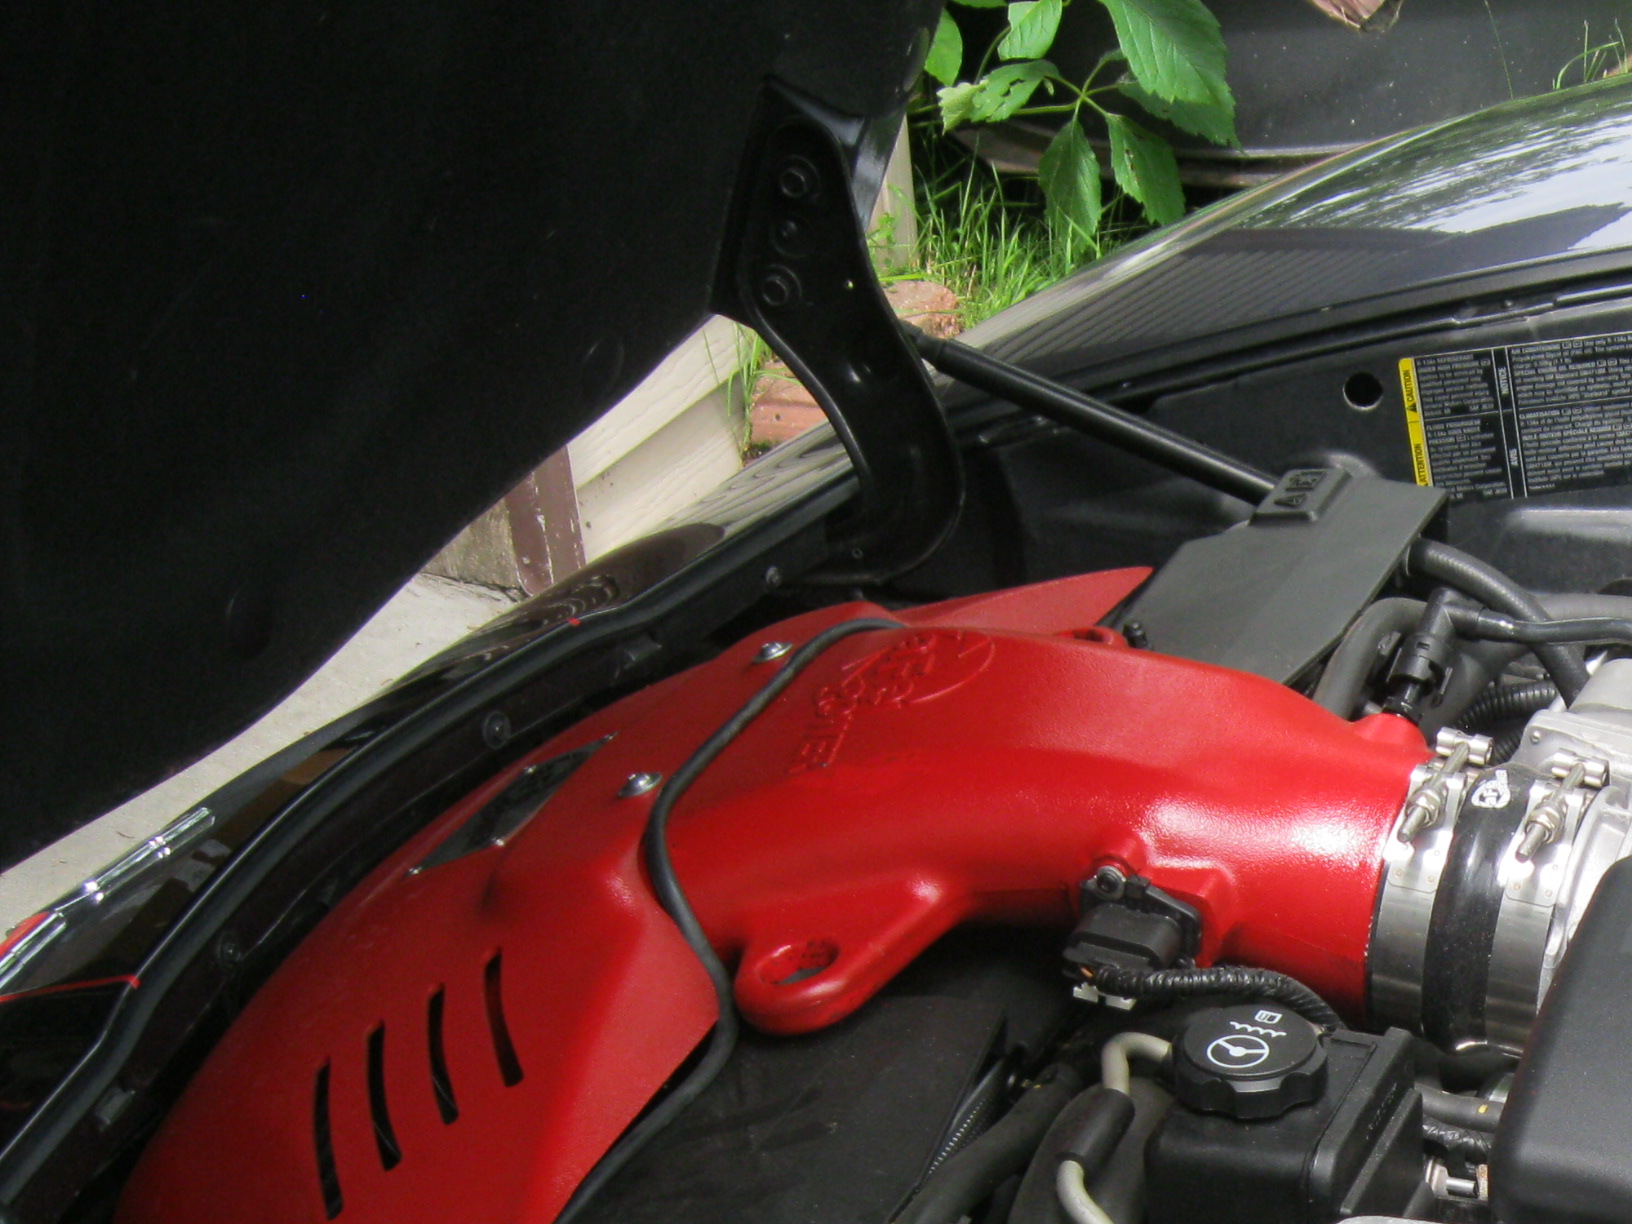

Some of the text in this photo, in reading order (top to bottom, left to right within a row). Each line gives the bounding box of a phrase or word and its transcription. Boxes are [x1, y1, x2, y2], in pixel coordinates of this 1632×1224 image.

[1403, 369, 1413, 402] CAUTION
[1498, 367, 1509, 395] NOTICE
[1414, 443, 1427, 485] ATTENTION
[1509, 448, 1518, 466] AVIS
